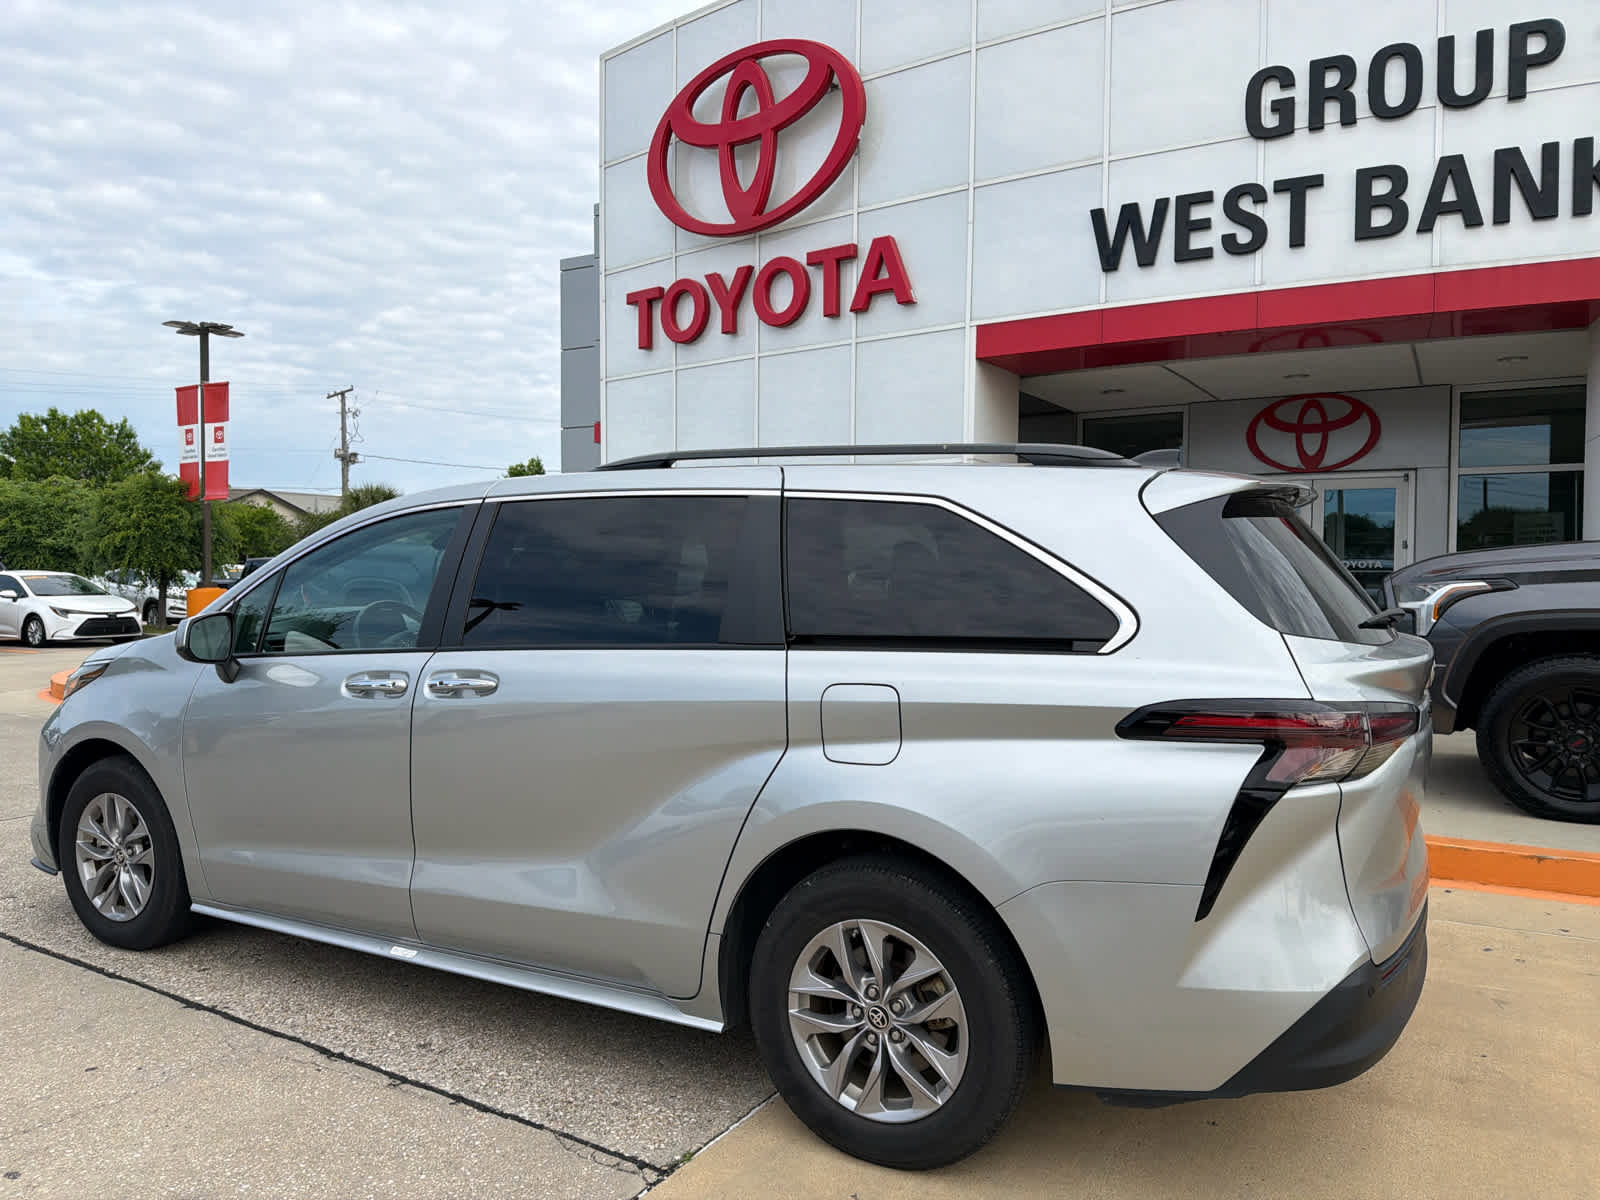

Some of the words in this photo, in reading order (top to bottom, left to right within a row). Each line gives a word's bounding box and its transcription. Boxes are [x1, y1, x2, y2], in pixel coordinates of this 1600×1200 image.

[1245, 18, 1566, 140] GROUP
[1090, 174, 1324, 272] WEST
[626, 235, 917, 350] TOYOTA
[1341, 560, 1384, 569] OYOTA
